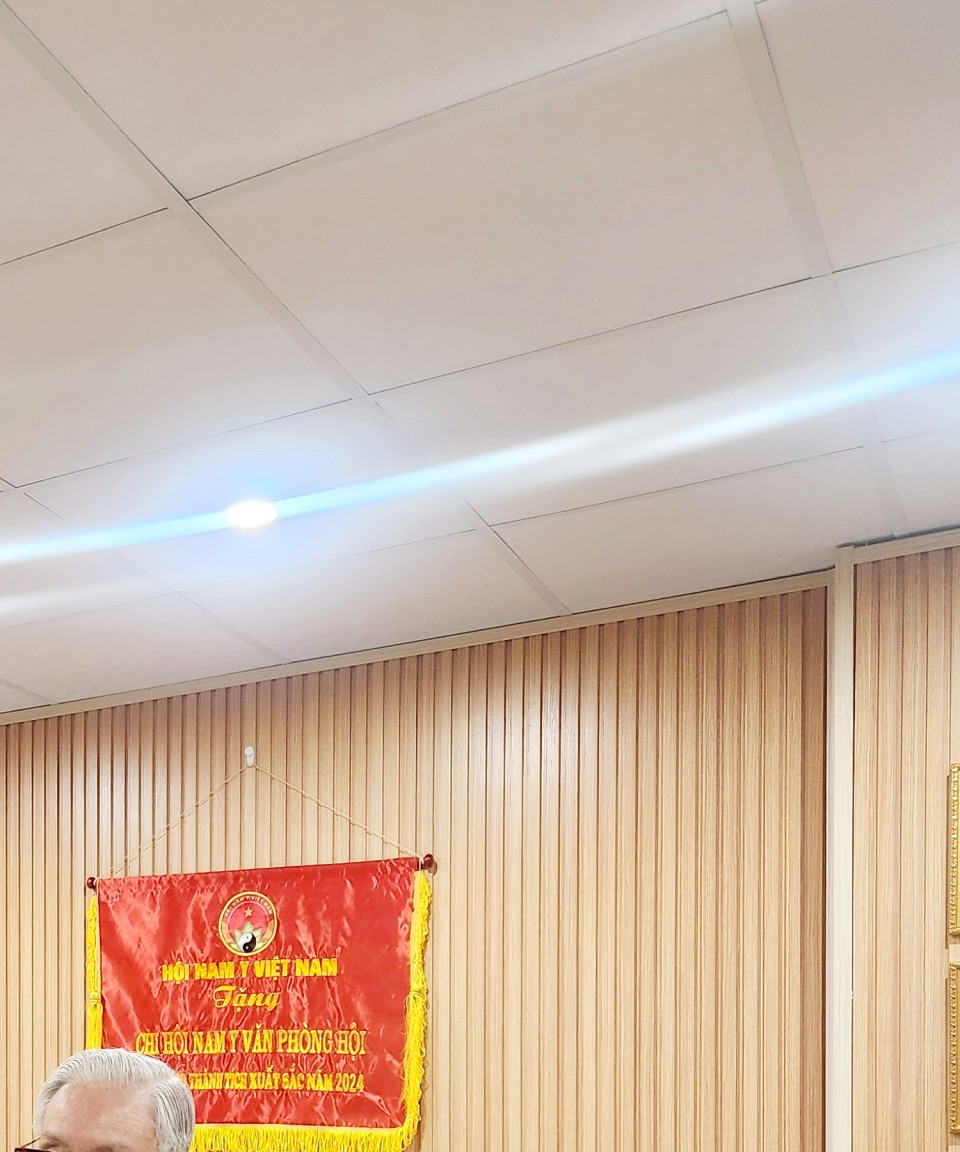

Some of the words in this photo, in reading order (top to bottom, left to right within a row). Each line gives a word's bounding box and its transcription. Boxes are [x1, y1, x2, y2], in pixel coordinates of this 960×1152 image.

[162, 960, 190, 985] HỘI
[194, 961, 235, 980] NAM
[240, 960, 250, 978] Y
[254, 955, 290, 981] VIỆT
[295, 957, 338, 978] NAM
[212, 985, 281, 1013] Tặng
[135, 1030, 159, 1055] CHI
[163, 1024, 189, 1060] HỘI
[192, 1030, 226, 1055] NAM
[228, 1030, 238, 1054] Y
[243, 1022, 273, 1054] VĂN
[277, 1022, 334, 1054] PHÒNG
[337, 1021, 367, 1061] HỘI
[189, 1067, 223, 1090] THÀNH
[224, 1067, 248, 1090] TÍCH
[249, 1065, 280, 1090] XUẤT
[281, 1063, 305, 1090] SẮC
[306, 1069, 334, 1092] NĂM
[335, 1072, 364, 1093] 2024
